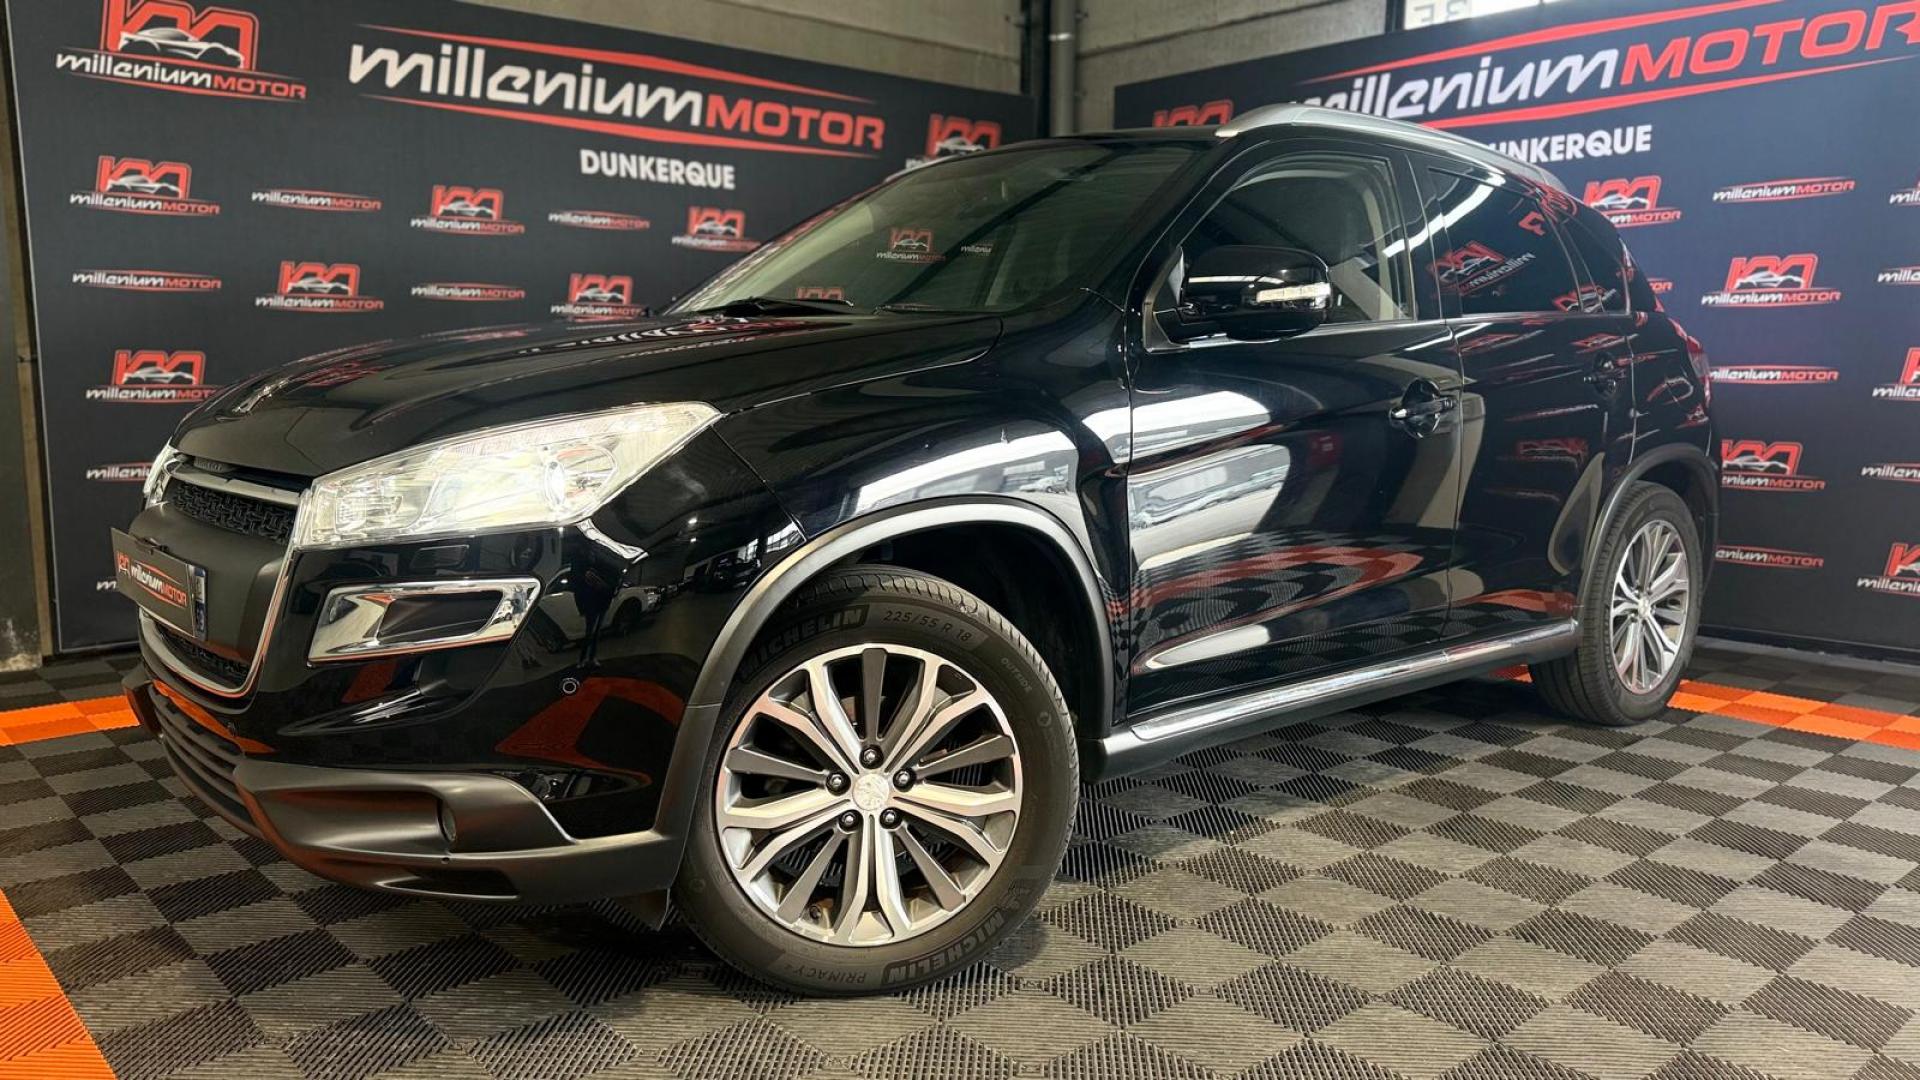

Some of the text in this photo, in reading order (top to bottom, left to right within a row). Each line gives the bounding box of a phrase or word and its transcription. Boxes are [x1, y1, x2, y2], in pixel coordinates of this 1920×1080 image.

[1486, 125, 1652, 165] UNKERQUE
[580, 149, 735, 190] DUNKERQUE
[883, 609, 973, 643] 225/55 R 18
[886, 910, 1005, 985] MICHELIN
